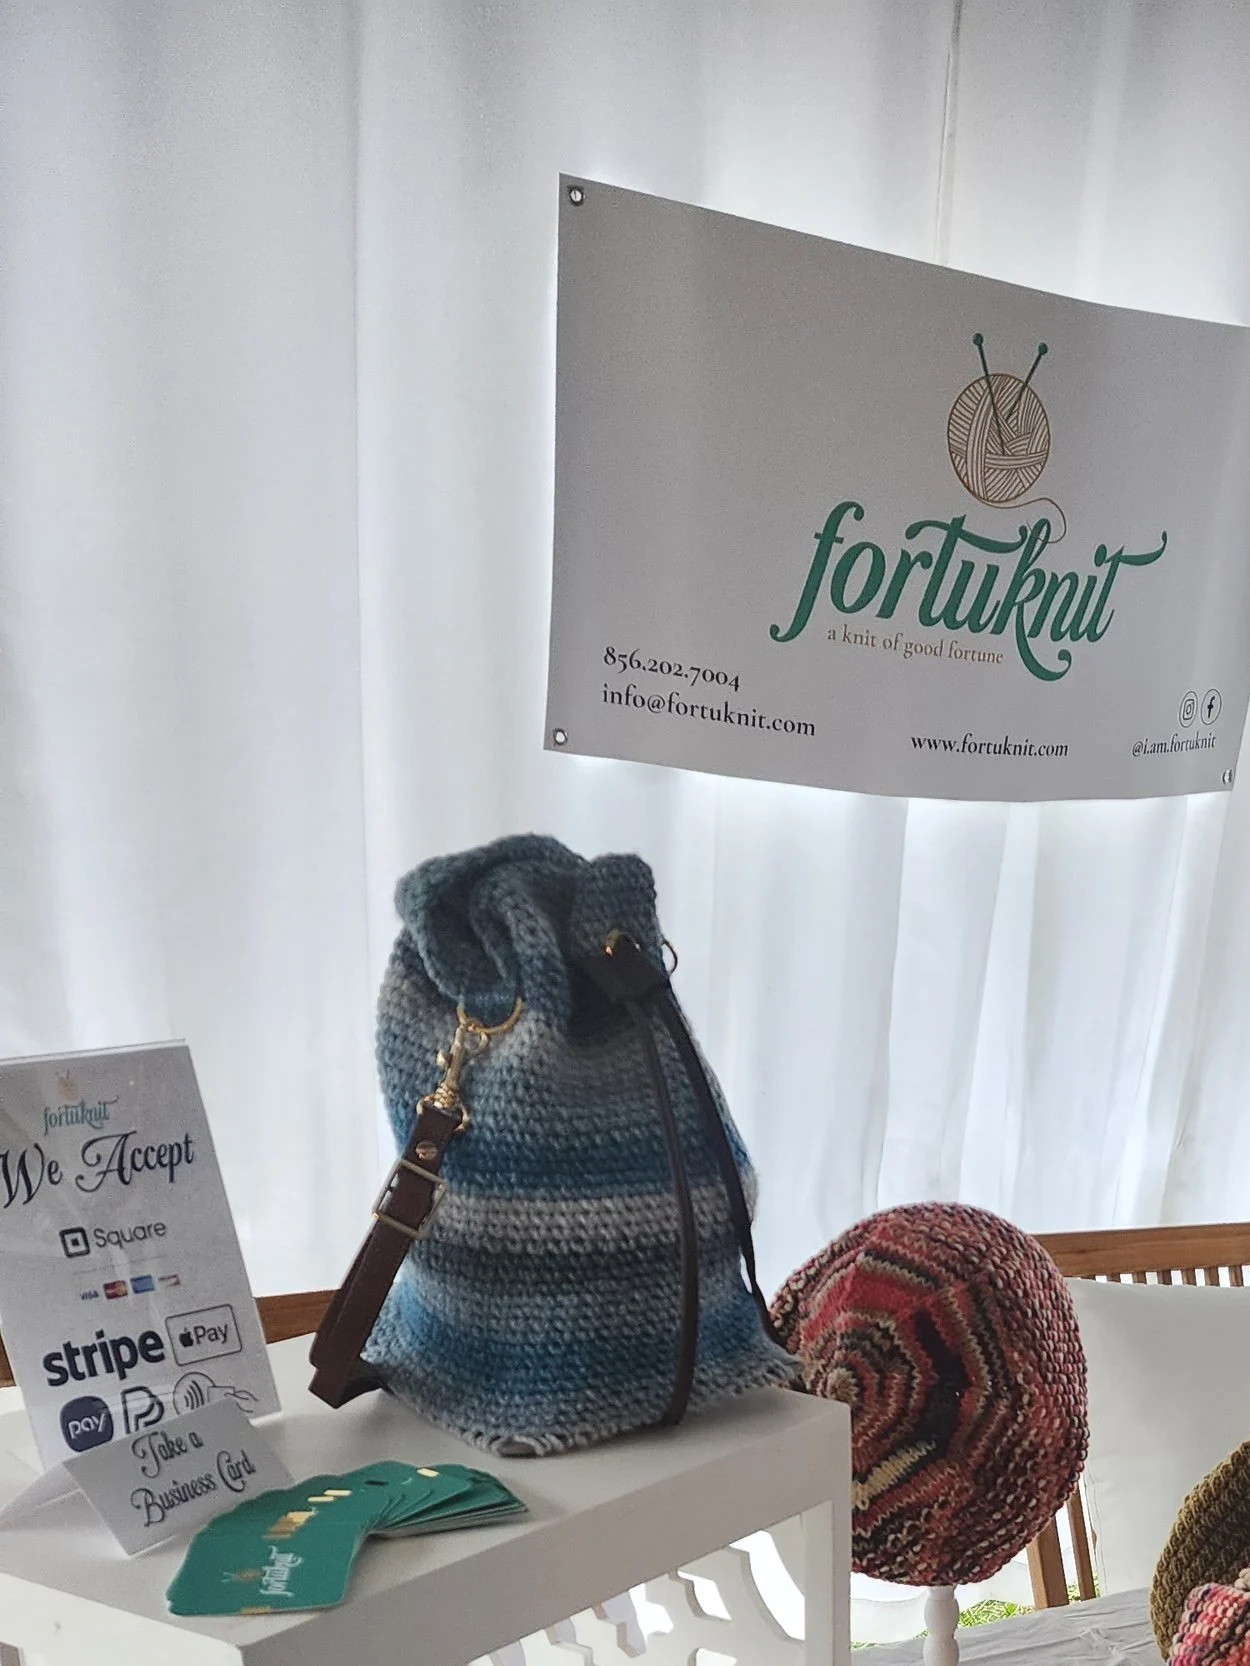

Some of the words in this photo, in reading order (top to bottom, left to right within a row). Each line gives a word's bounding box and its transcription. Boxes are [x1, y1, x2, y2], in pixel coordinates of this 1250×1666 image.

[770, 501, 1168, 682] fortuknit
[827, 628, 837, 641] a
[842, 624, 877, 648] knit
[882, 632, 904, 651] of
[903, 639, 944, 660] good
[948, 640, 1005, 664] fortune
[603, 646, 741, 692] 856.202.7004
[602, 683, 816, 737] info@fortuknit.com
[910, 733, 1069, 757] www.fortuknit.com
[1132, 731, 1217, 757] @i.am.fortuknit
[44, 1094, 119, 1137] fortuknit
[0, 1142, 63, 1209] We
[75, 1130, 193, 1193] Accept
[93, 1221, 167, 1249] Square
[193, 1323, 229, 1345] Pay
[43, 1329, 165, 1387] stripe
[131, 1431, 187, 1479] Take
[188, 1432, 203, 1449] a
[130, 1473, 217, 1528] Business
[216, 1449, 256, 1493] Card
